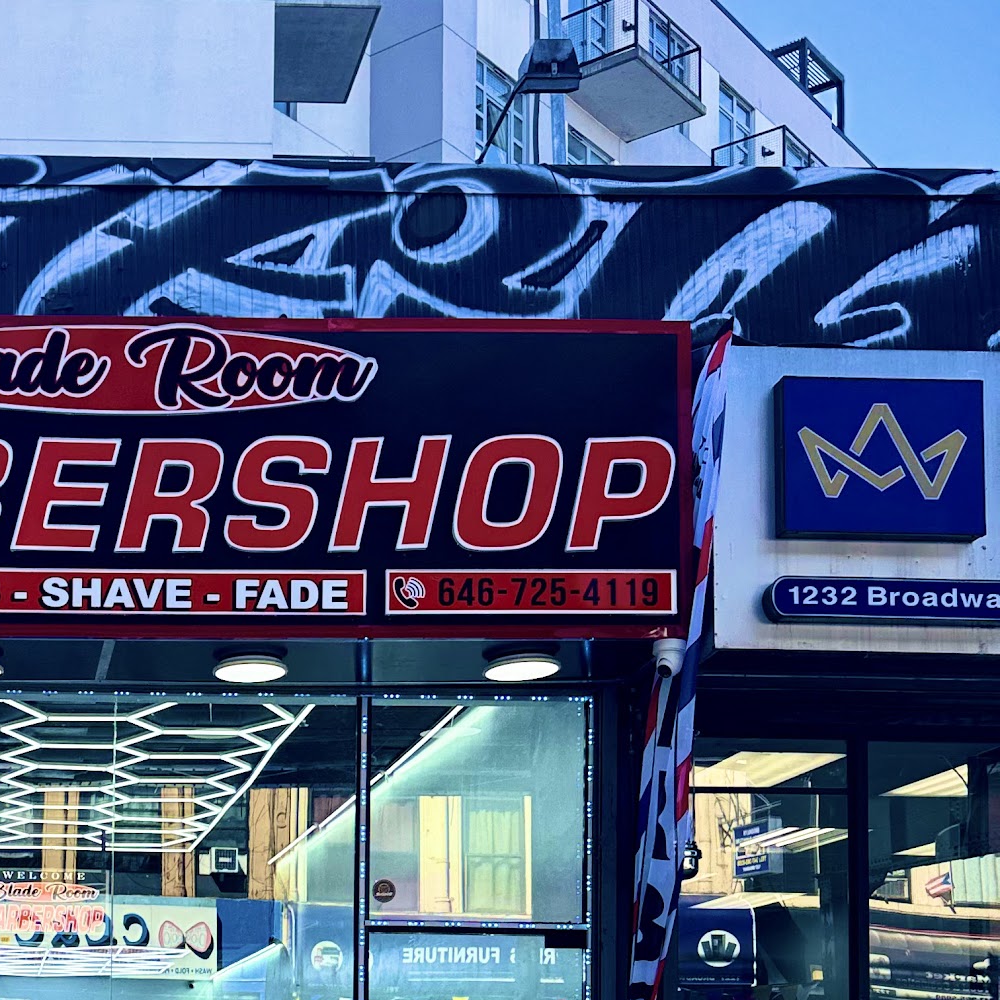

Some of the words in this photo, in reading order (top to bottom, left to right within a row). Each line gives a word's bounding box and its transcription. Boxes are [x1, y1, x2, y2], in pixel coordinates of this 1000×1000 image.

[124, 324, 378, 412] Room
[41, 576, 192, 609] SHAVE
[236, 579, 349, 610] FADE
[438, 576, 660, 608] 646-725-4119
[788, 585, 858, 606] 1232
[2, 871, 86, 880] WELCOME
[46, 882, 100, 901] Room
